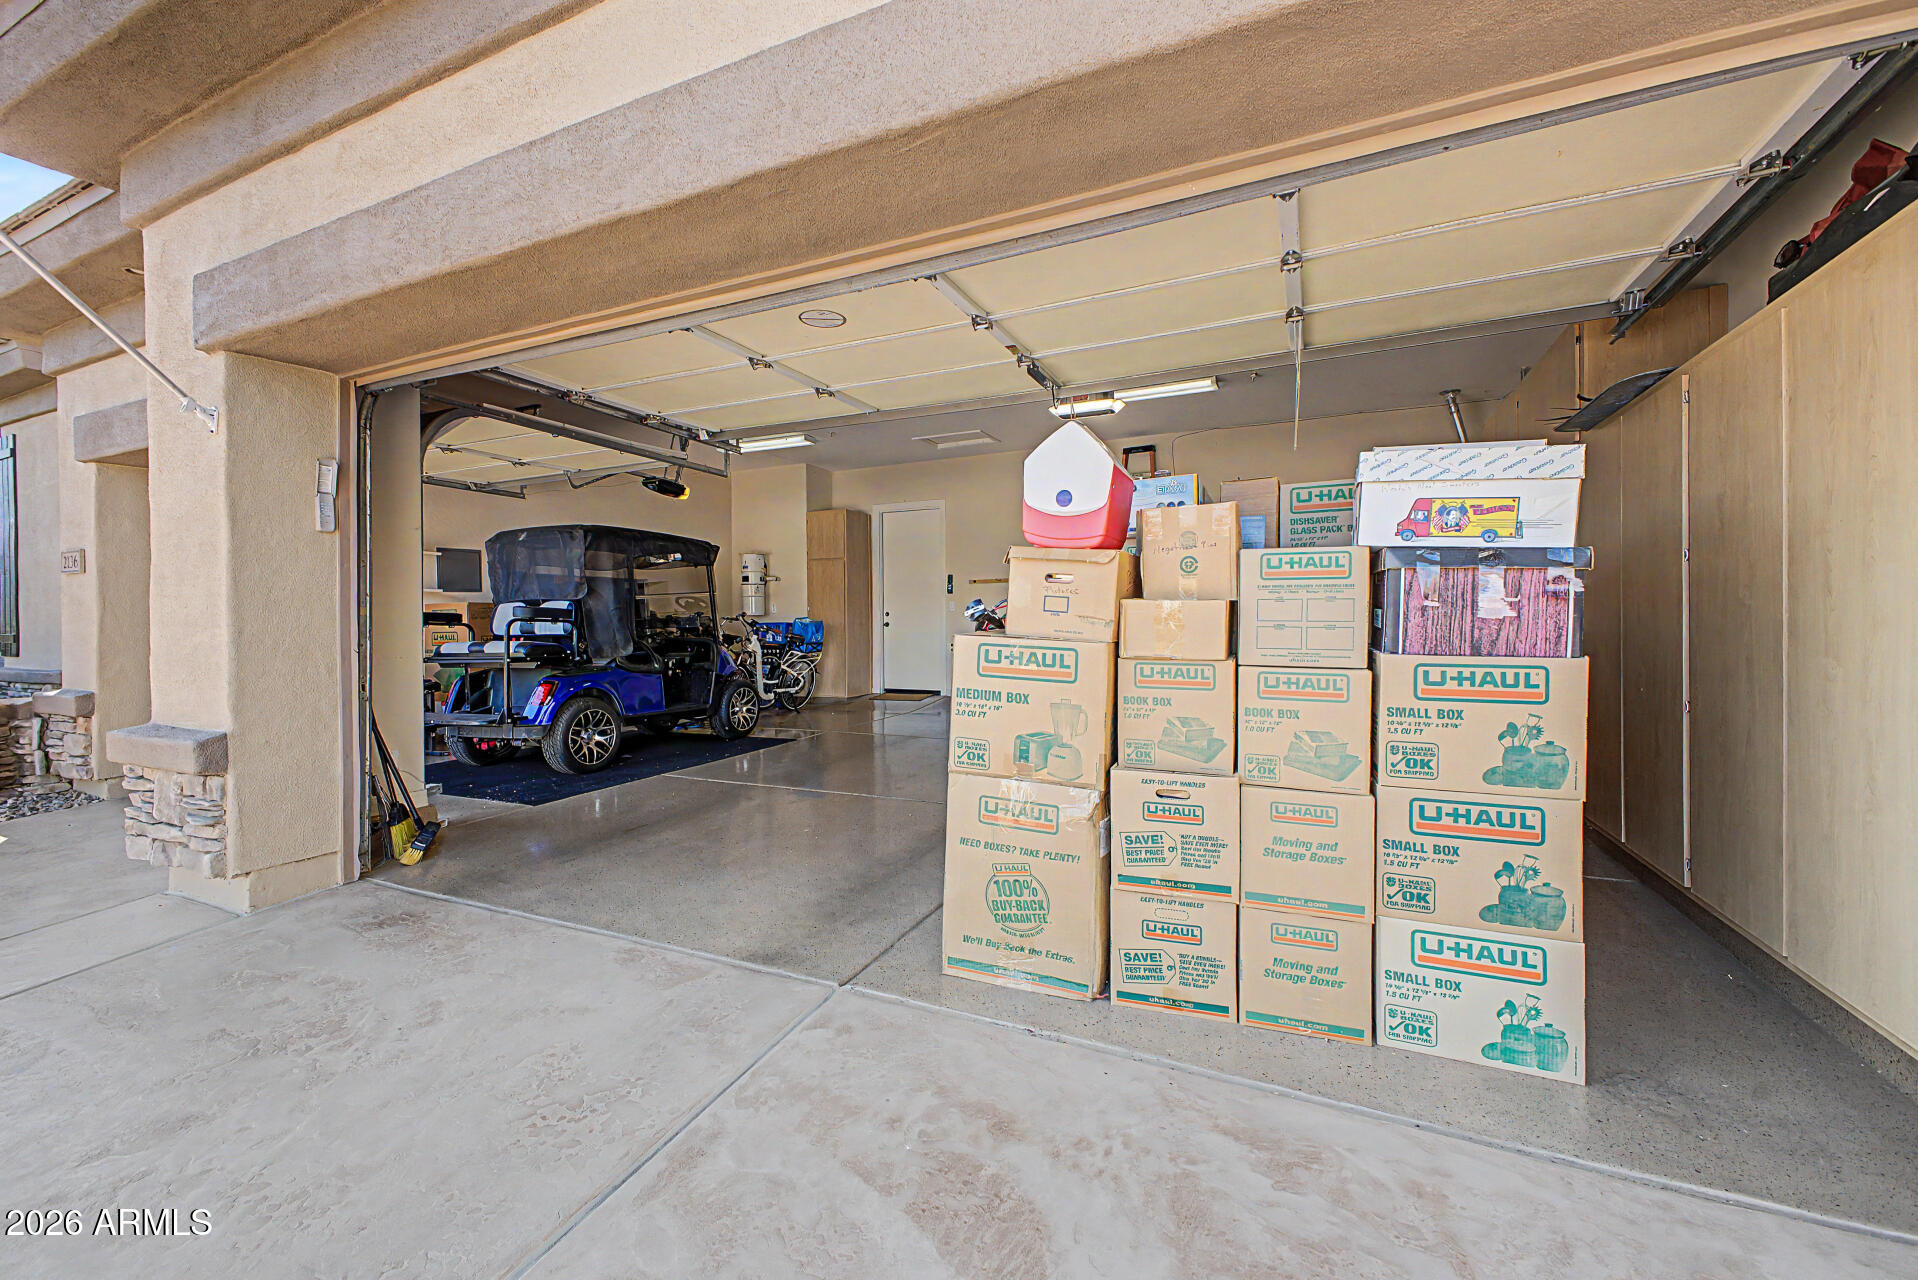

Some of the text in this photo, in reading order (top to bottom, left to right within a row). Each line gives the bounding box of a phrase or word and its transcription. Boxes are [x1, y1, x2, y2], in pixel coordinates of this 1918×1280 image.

[1290, 515, 1337, 526] DISHSAVER
[1290, 526, 1318, 535] GLASS
[1320, 524, 1343, 533] PACK
[63, 554, 79, 569] 2136
[1266, 555, 1346, 570] U-HAUL
[984, 649, 1072, 670] U-HAUL
[1139, 666, 1211, 680] U-HAUL
[1423, 669, 1541, 689] U-HAUL
[1263, 676, 1344, 692] U-HAUL
[956, 687, 1030, 705] MEDIUM BOX
[1123, 695, 1172, 707] BOOK BOX
[1244, 706, 1300, 720] BOOK BOX
[1386, 706, 1465, 721] SMALL BOX
[967, 751, 986, 762] OK
[1135, 750, 1152, 759] OK
[1258, 766, 1277, 775] OK
[1405, 757, 1434, 770] OK
[1179, 780, 1206, 788] HANDLES
[984, 799, 1055, 823] U-HAUL
[1146, 804, 1200, 818] U-HAUL
[1275, 804, 1334, 820] U-HAUL
[1418, 804, 1536, 830] U-HAUL
[1124, 834, 1165, 845] SAVE!
[1272, 835, 1338, 852] Moving and
[959, 836, 1081, 864] NEED BOXES? TAKE PLENTY!
[1125, 849, 1142, 857] BEST
[1382, 838, 1461, 857] SMALL BOX
[1262, 847, 1345, 865] Storage Boxes
[993, 878, 1039, 898] 100%
[1150, 879, 1196, 889] uhaul.com
[1178, 899, 1205, 909] HANDLES
[1277, 897, 1328, 909] uhaul.com
[1402, 890, 1431, 904] OK
[992, 899, 1046, 912] BUY-BACK
[993, 912, 1049, 924] GUARANTEE
[1145, 922, 1199, 938] U-HAUL
[1275, 926, 1334, 943] U-HAUL
[962, 934, 983, 946] We'll
[1027, 945, 1043, 957] the
[1045, 949, 1076, 964] Extras.
[1420, 936, 1538, 970] U-HAUL
[1123, 952, 1162, 963] SAVE!
[1124, 966, 1142, 974] BEST
[1272, 957, 1339, 976] Moving and
[1263, 968, 1344, 989] Storage Boxes
[1384, 969, 1430, 987] SMALL
[1434, 977, 1463, 992] BOX
[1149, 996, 1194, 1008] uhaul.com
[1399, 992, 1410, 1000] CU
[1278, 1018, 1328, 1031] uhaul.com
[1404, 1022, 1432, 1038] OK
